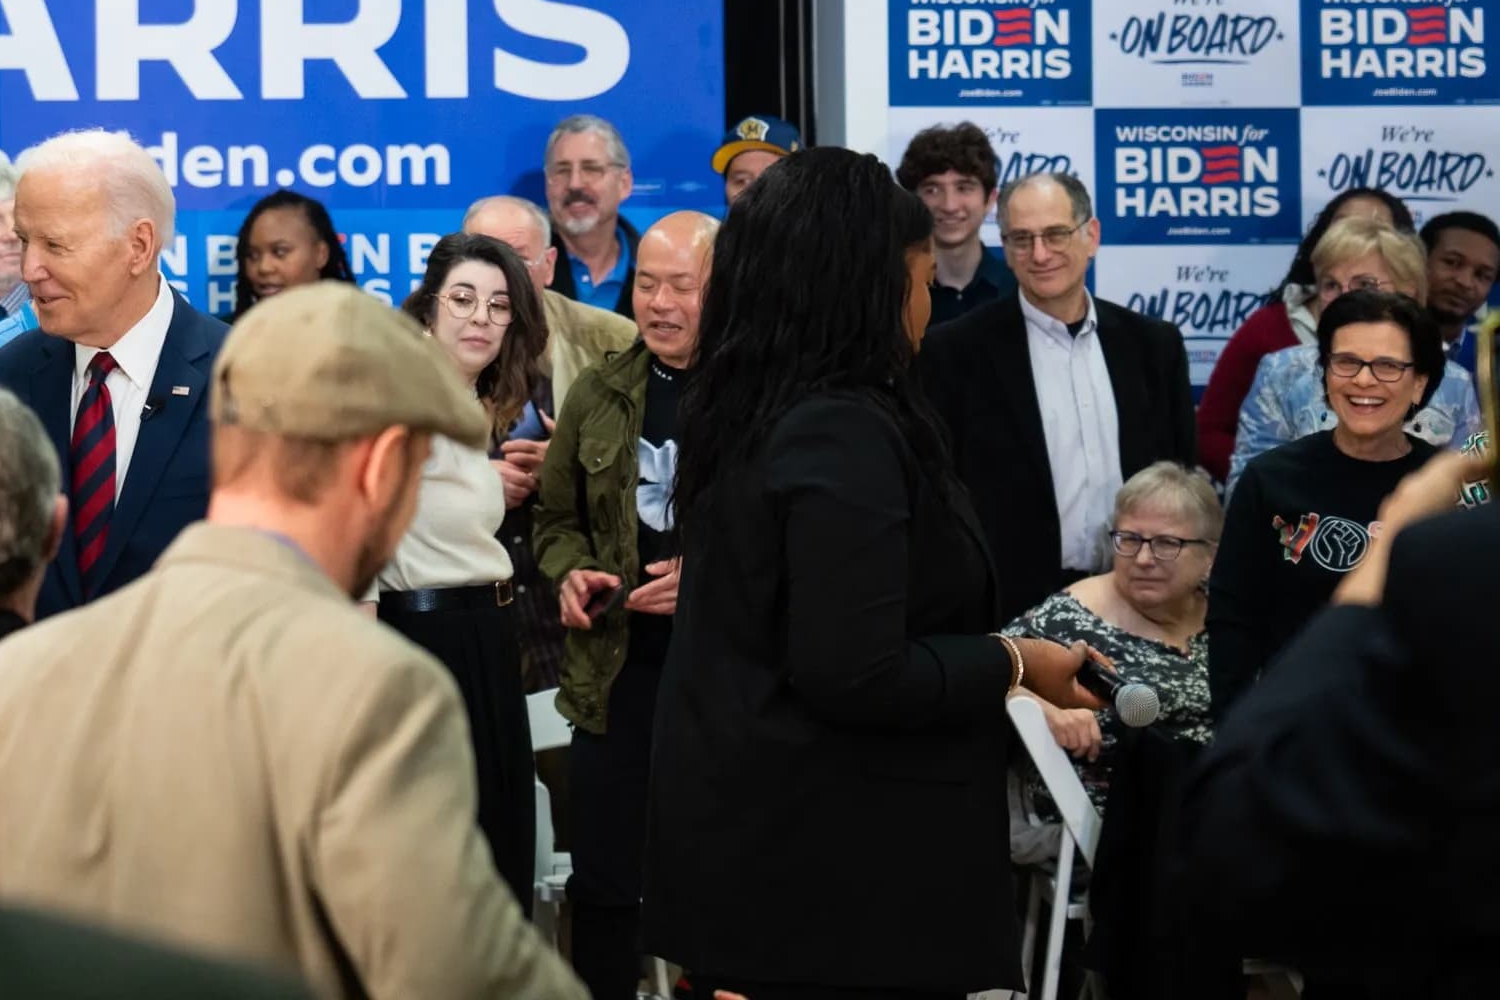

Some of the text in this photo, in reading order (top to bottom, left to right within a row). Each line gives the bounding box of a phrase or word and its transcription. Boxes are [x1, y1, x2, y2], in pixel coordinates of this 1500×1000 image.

[908, 8, 1069, 46] BIDEN
[1321, 7, 1484, 45] BIDEN
[908, 49, 1071, 79] HARRIS
[1321, 47, 1486, 78] HARRIS
[1116, 125, 1268, 146] WISCONSIN for
[1382, 126, 1434, 143] We're
[1115, 146, 1278, 184] BIDEN
[1116, 186, 1280, 217] HARRIS
